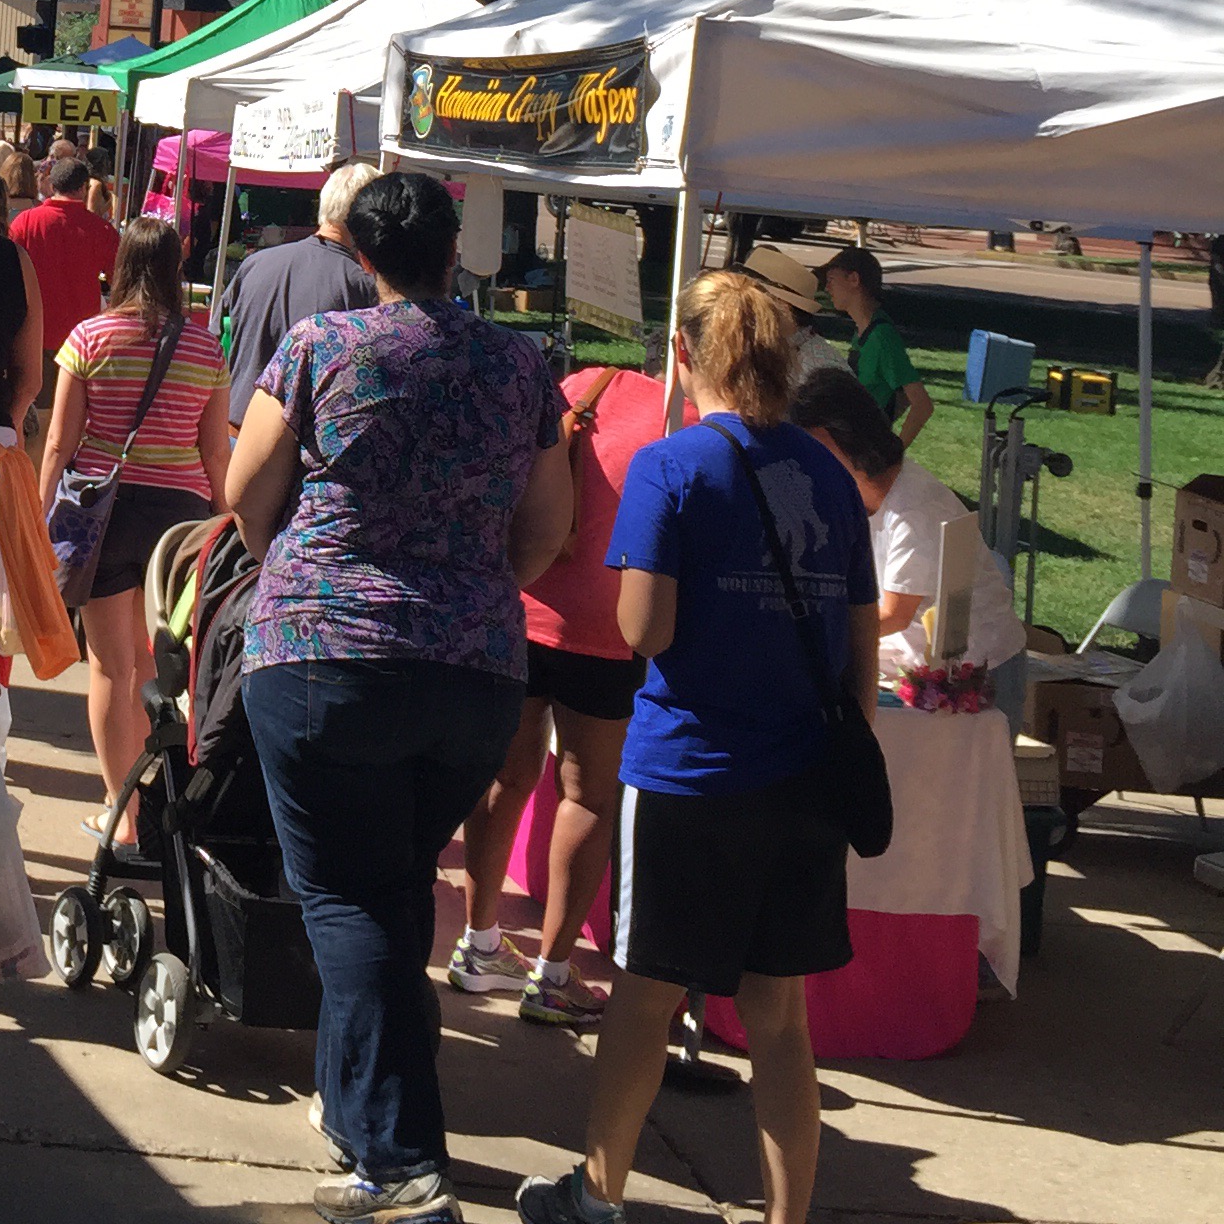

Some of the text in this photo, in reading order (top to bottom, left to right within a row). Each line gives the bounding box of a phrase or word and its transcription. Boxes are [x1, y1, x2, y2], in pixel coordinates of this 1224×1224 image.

[34, 93, 107, 123] TEA
[436, 67, 638, 144] Hawaiian Crispy Wafers
